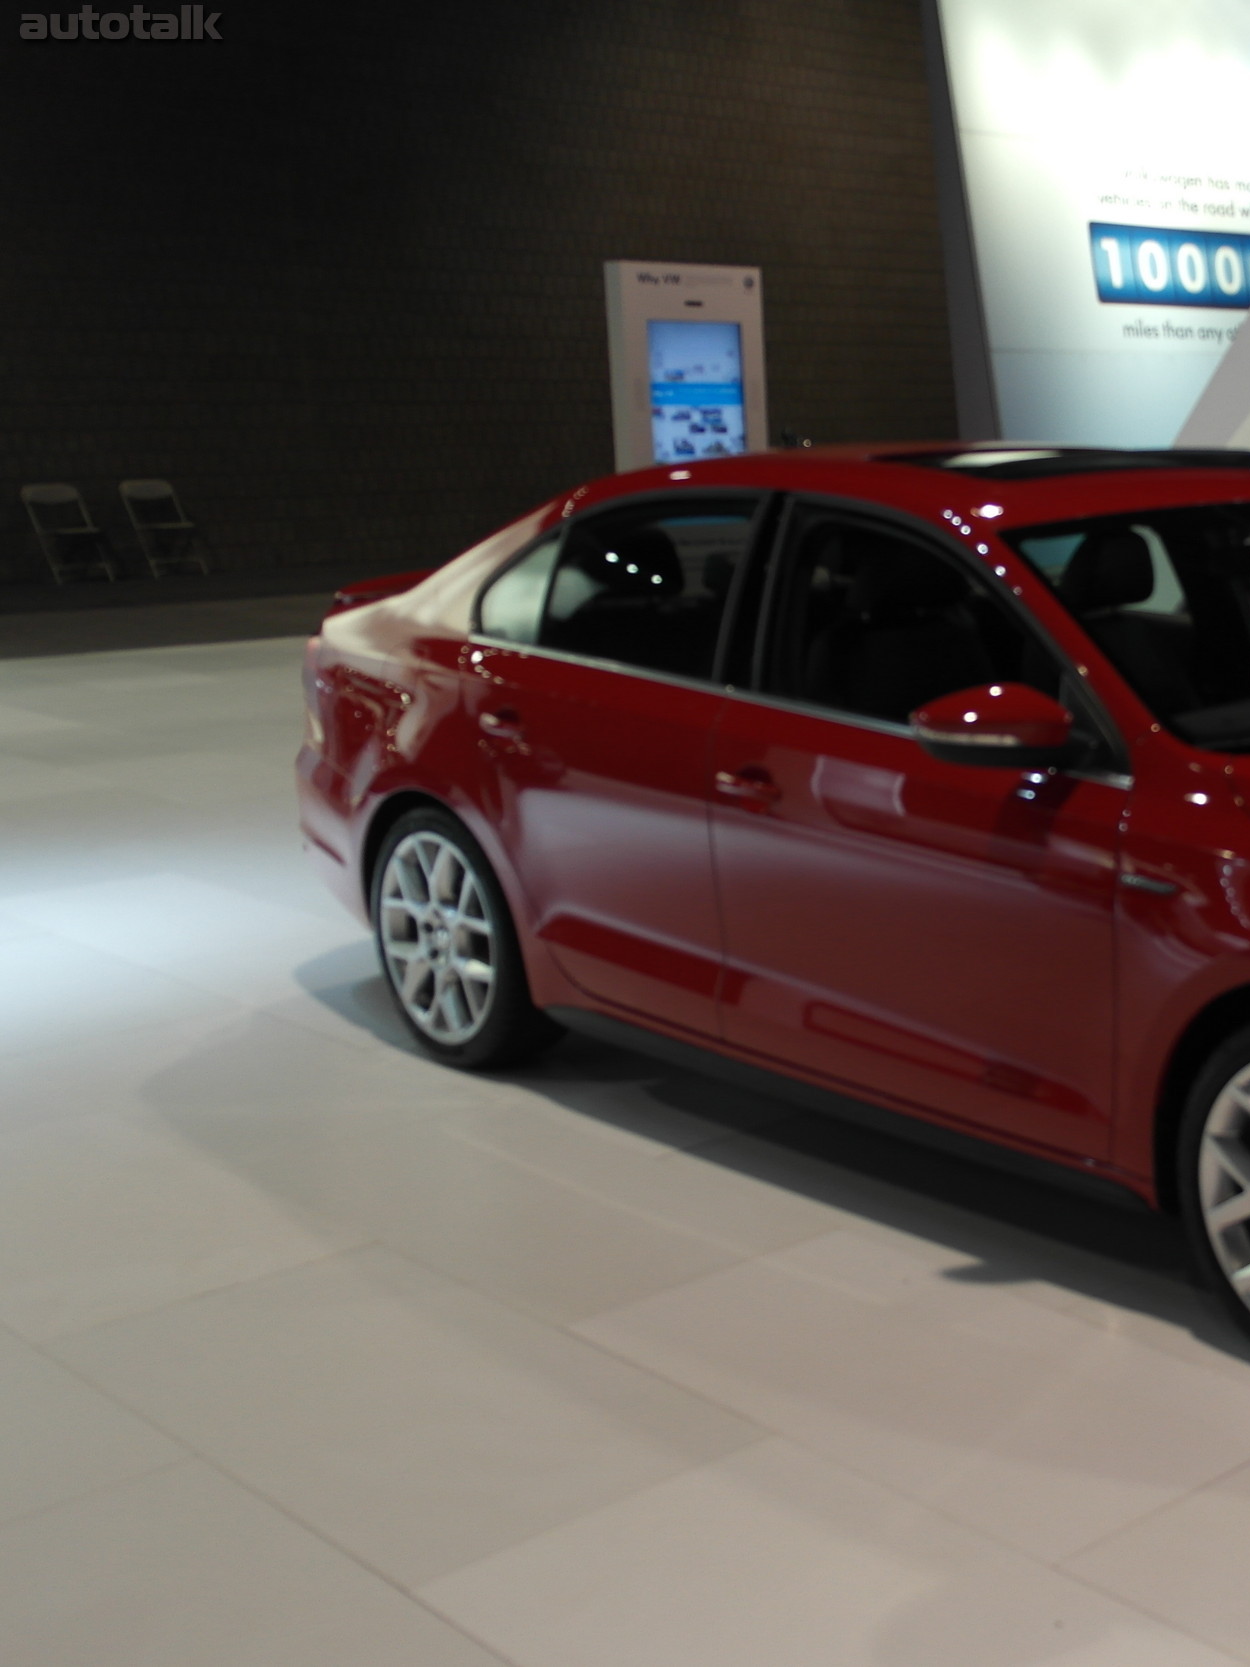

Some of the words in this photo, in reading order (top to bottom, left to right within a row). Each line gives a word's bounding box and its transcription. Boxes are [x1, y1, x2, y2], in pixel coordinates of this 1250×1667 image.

[1207, 175, 1230, 190] has
[1203, 200, 1236, 218] road
[1122, 319, 1158, 338] miles
[1162, 321, 1193, 340] than
[1197, 326, 1223, 345] any
